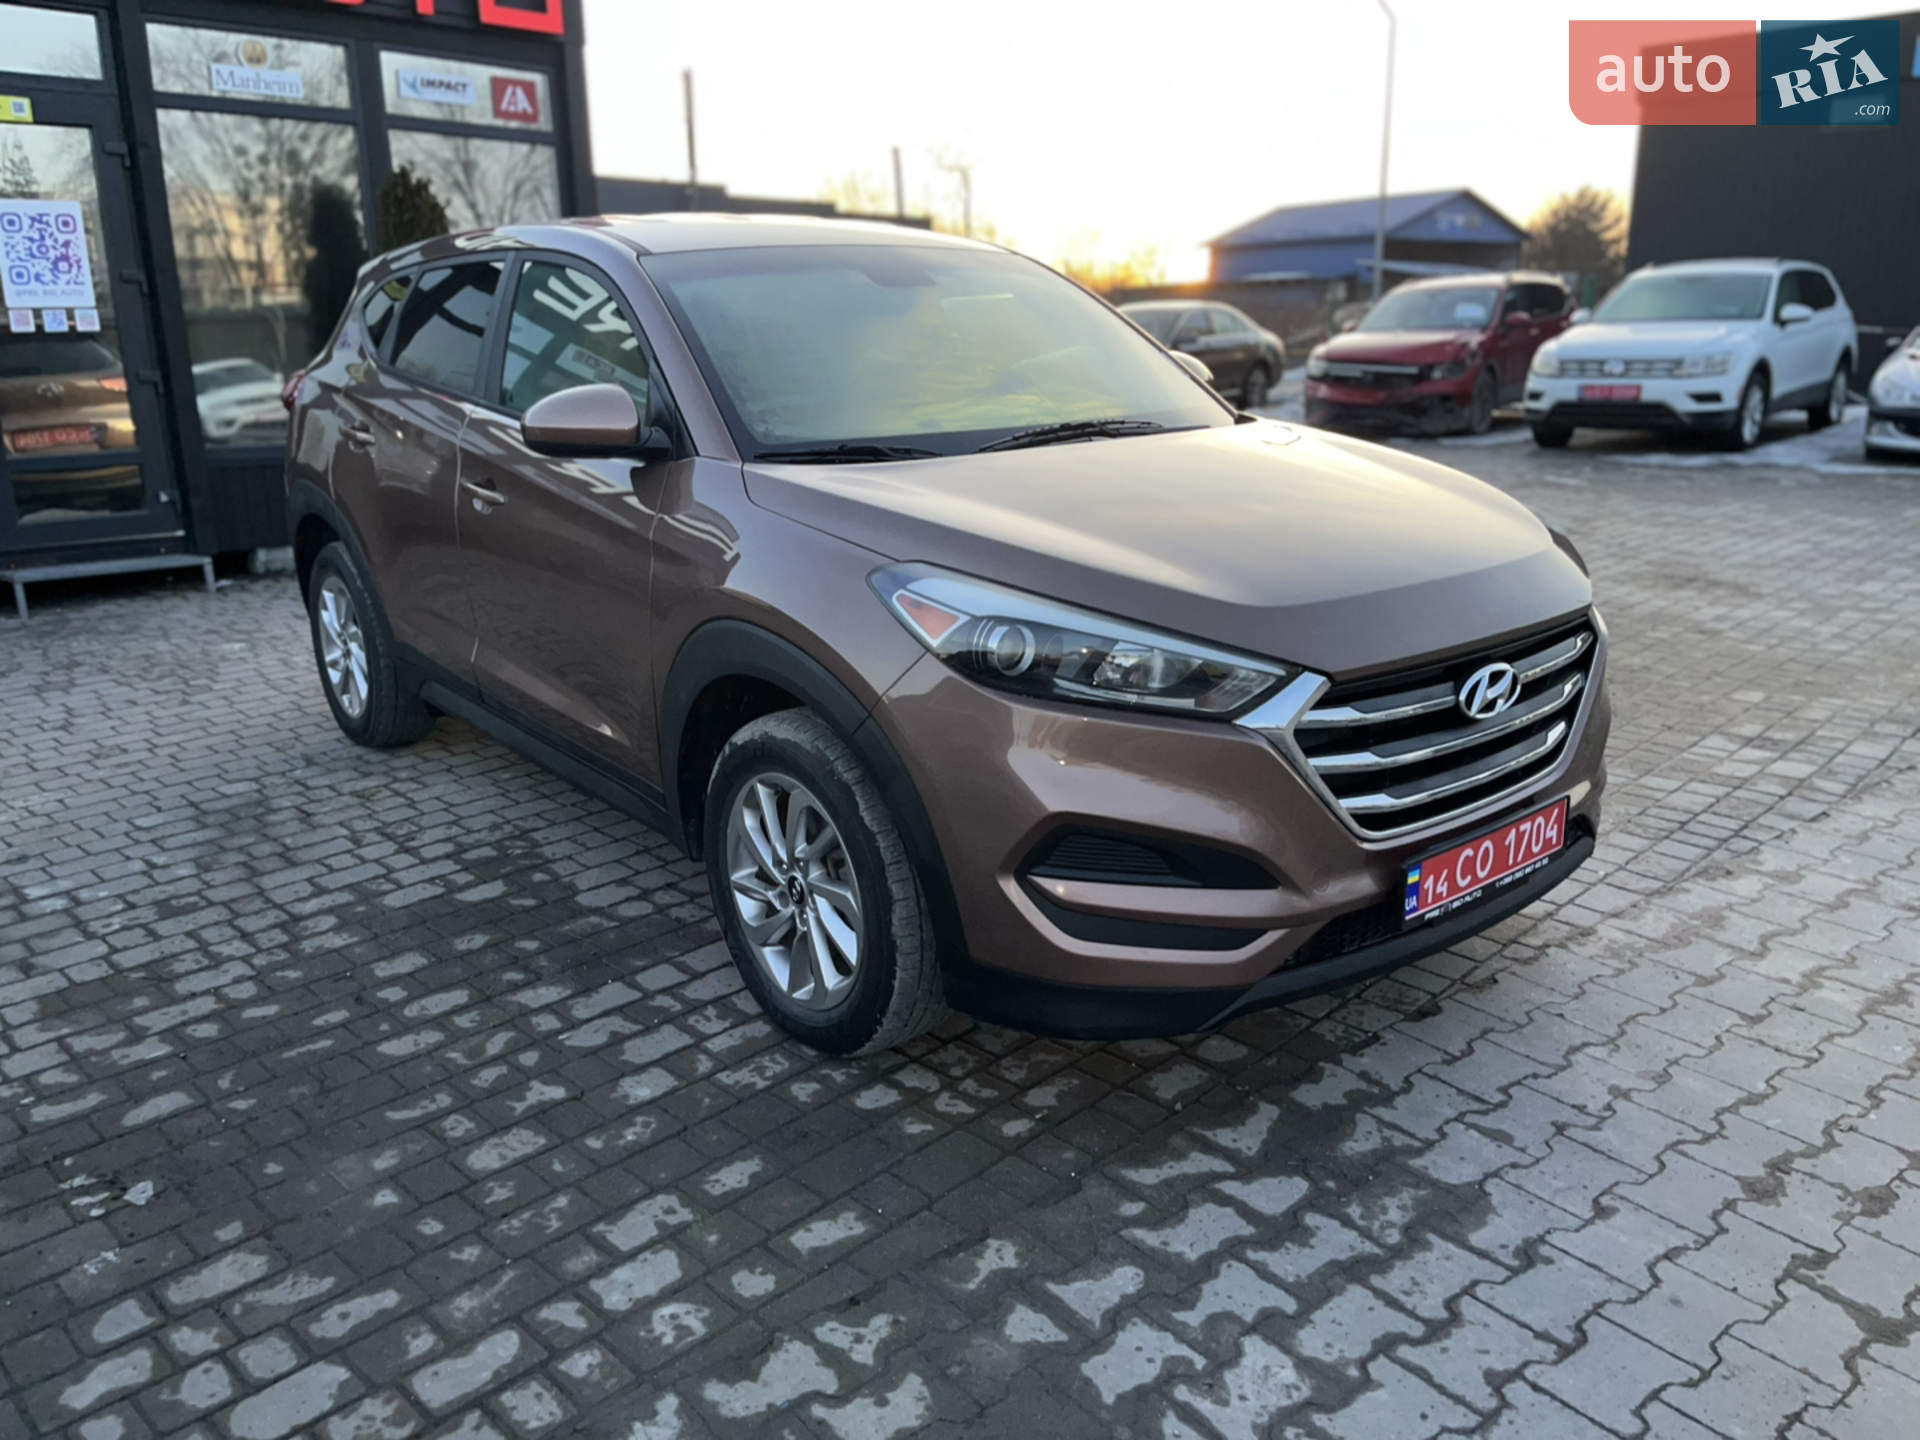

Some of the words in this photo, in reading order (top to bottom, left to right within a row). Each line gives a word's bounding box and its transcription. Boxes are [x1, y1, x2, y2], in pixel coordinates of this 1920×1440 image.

[215, 67, 301, 95] Manheim
[420, 77, 468, 95] IMPACT
[1424, 869, 1448, 903] 14
[1456, 840, 1494, 888] CO
[1505, 808, 1559, 866] 1704
[1405, 897, 1417, 910] UA
